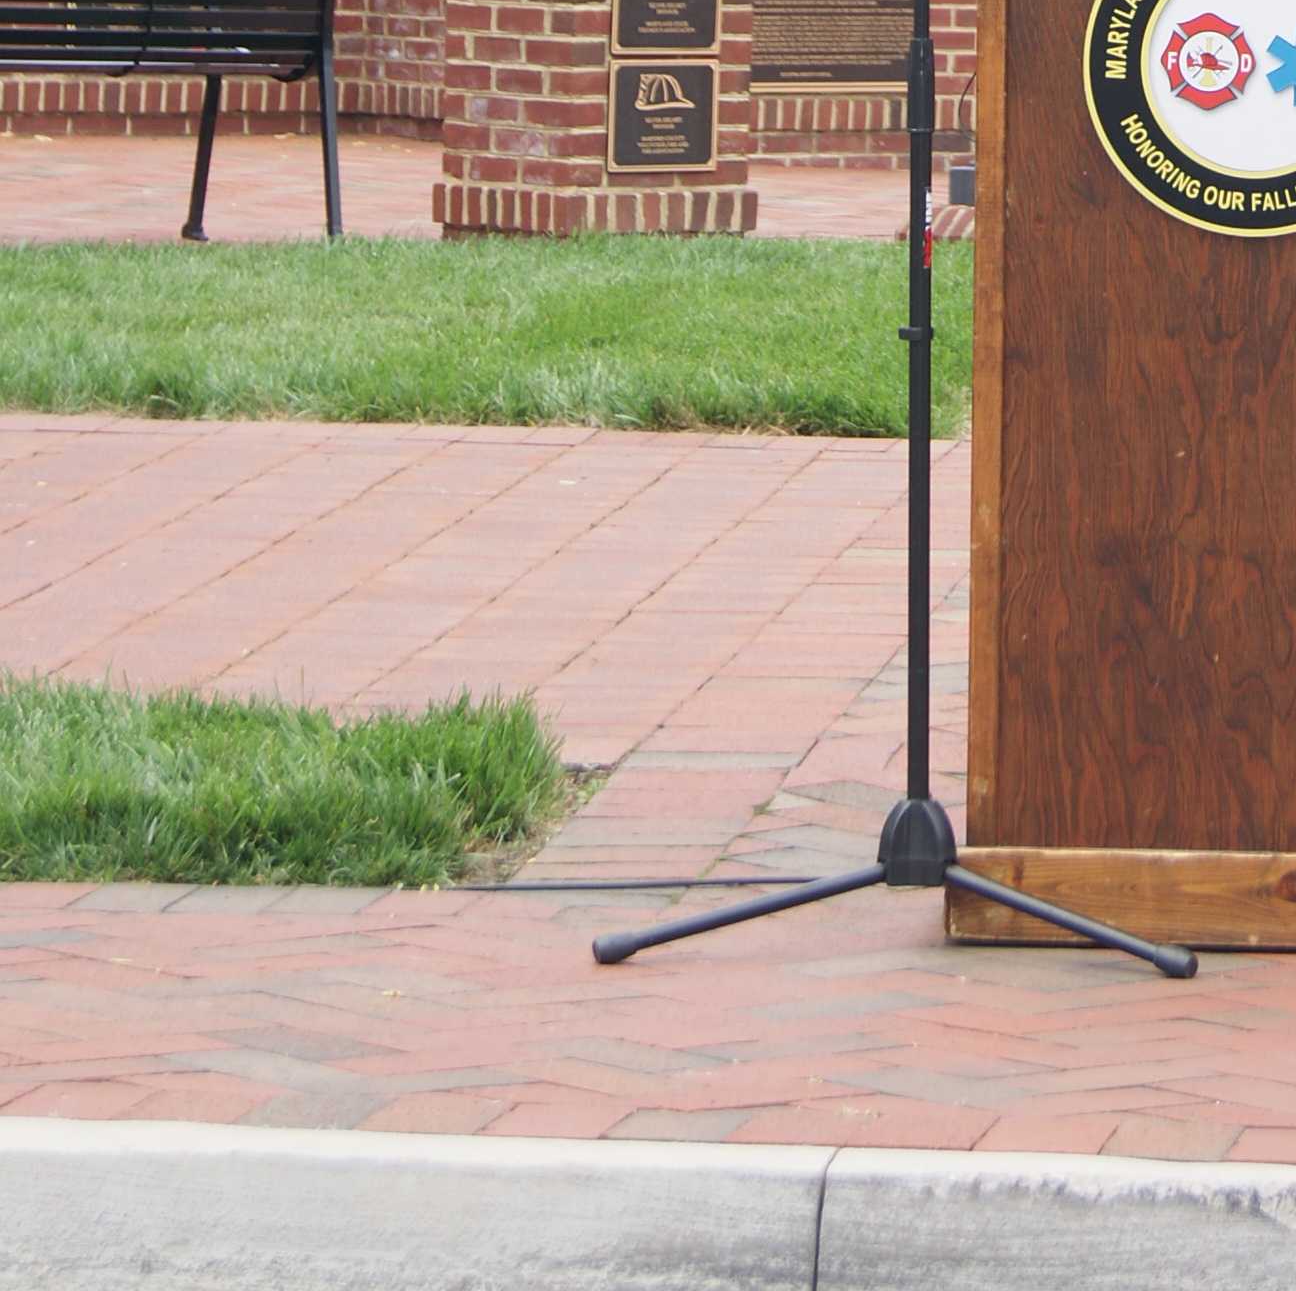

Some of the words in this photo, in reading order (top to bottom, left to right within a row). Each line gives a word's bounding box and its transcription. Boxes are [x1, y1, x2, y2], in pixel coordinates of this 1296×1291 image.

[1167, 52, 1178, 70] F
[1240, 54, 1252, 73] D
[1121, 113, 1200, 200] HONORING
[1203, 186, 1245, 211] OUR
